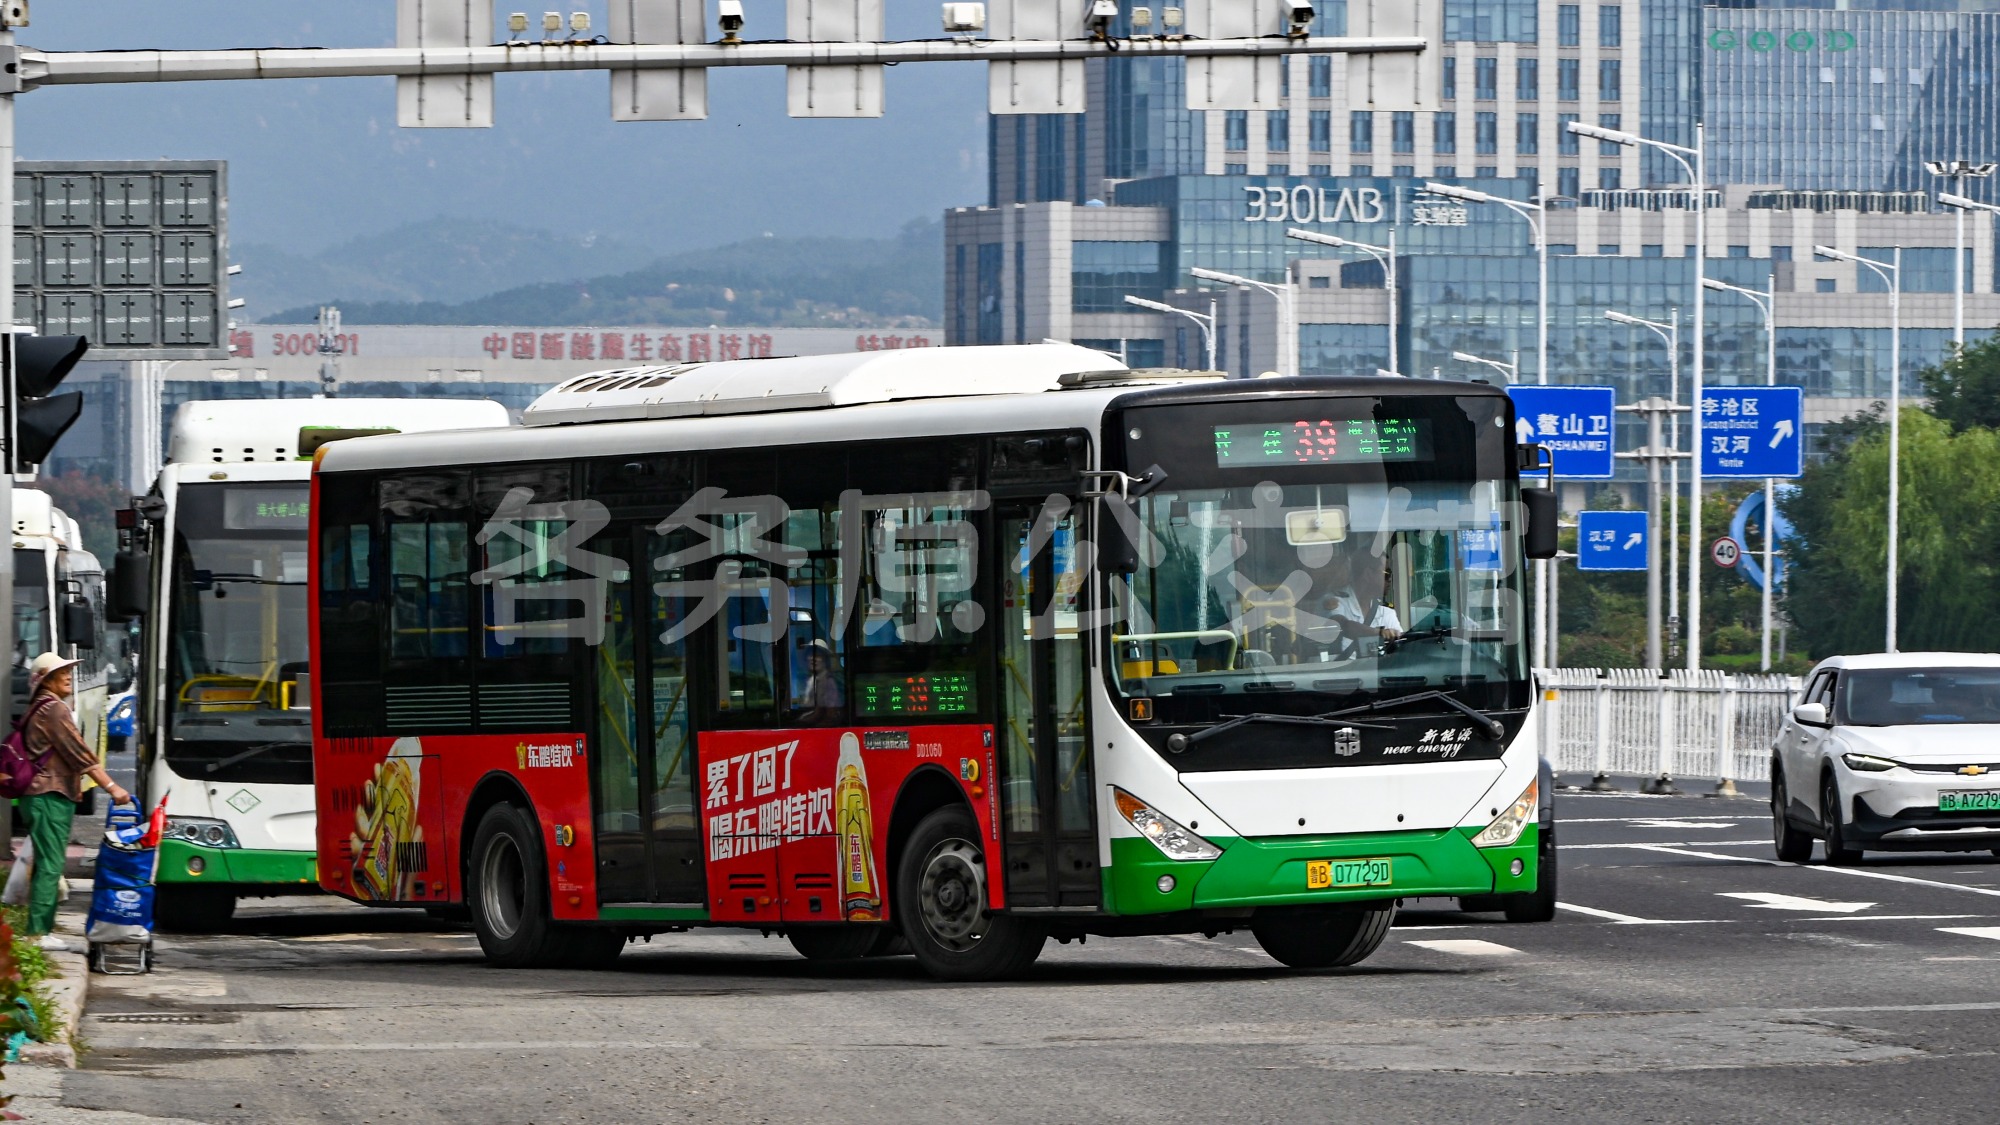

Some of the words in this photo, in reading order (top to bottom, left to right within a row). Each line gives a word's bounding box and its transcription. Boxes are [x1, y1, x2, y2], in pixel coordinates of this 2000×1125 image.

[1708, 30, 1856, 52] GOOD
[1243, 185, 1383, 223] 330LAB
[1413, 207, 1468, 226] 实验室
[272, 333, 359, 356] 30001
[482, 332, 774, 361] 中国新能源生态科技馆
[1701, 397, 1760, 416] 李沧区
[1536, 413, 1610, 436] 鳌山卫
[1711, 436, 1751, 454] 汉河
[1716, 544, 1736, 559] 40
[1419, 727, 1473, 743] 新能源
[527, 743, 573, 768] 东鹏特饮
[1382, 745, 1414, 756] new
[1416, 742, 1464, 759] energy
[706, 739, 800, 810] 累了困了
[709, 787, 833, 862] 喝东鹏特饮
